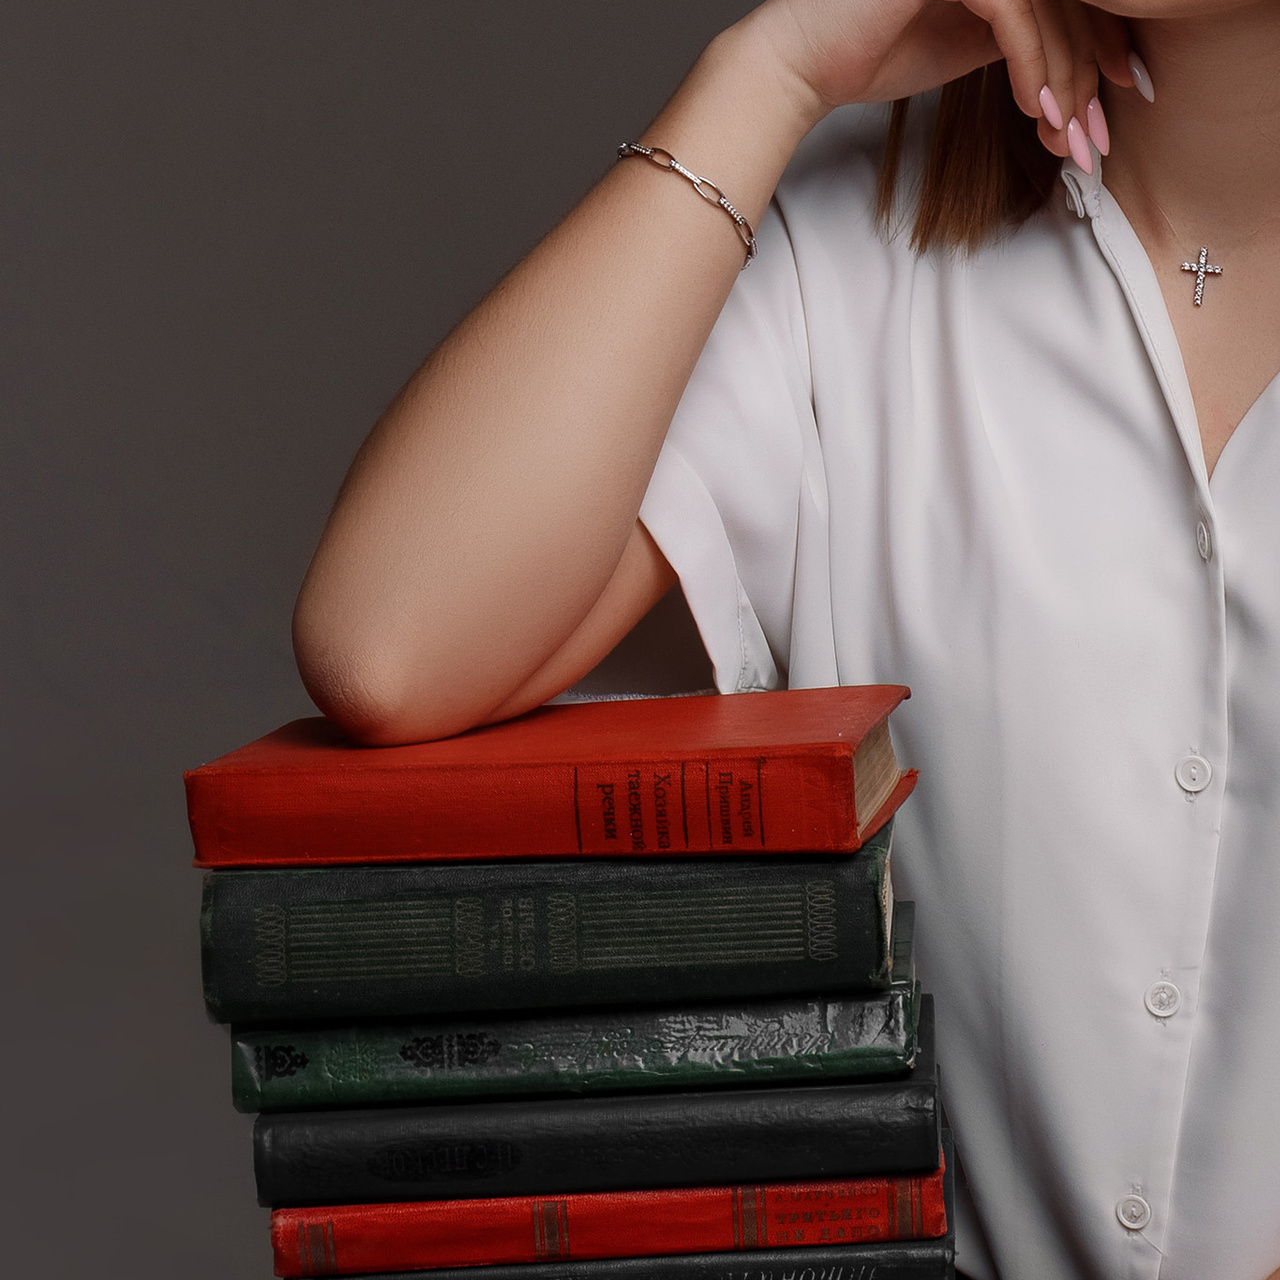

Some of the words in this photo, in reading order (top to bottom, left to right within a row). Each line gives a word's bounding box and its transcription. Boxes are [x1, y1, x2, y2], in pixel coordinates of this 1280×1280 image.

[597, 783, 618, 840] речки
[653, 773, 672, 850] Хозяйка
[715, 772, 733, 845] Пришвин
[775, 1207, 880, 1224] ТРЕТЬЕГО
[818, 1225, 880, 1243] ДАНО
